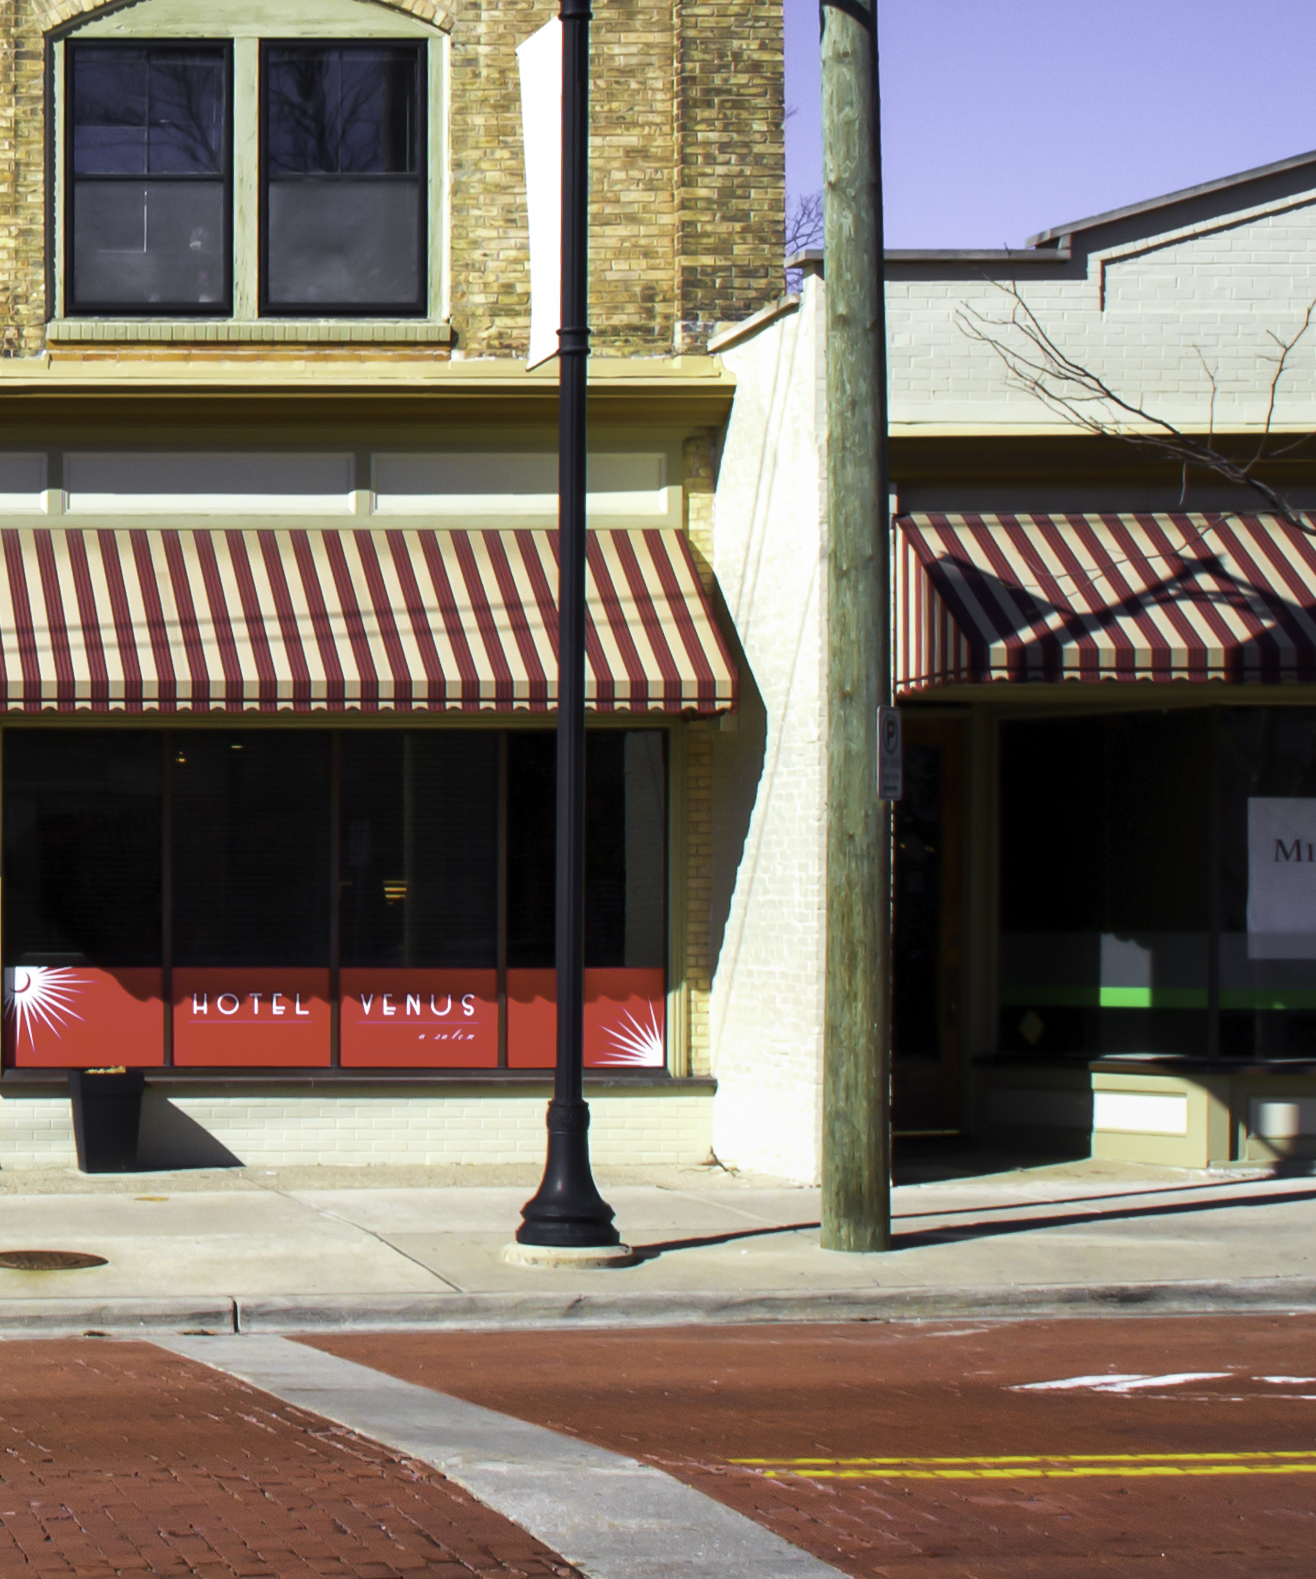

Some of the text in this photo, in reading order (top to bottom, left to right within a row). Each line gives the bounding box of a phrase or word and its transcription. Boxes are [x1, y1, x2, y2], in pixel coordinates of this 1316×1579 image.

[192, 992, 475, 1016] HOTEL VENUS
[433, 1029, 476, 1040] salon
